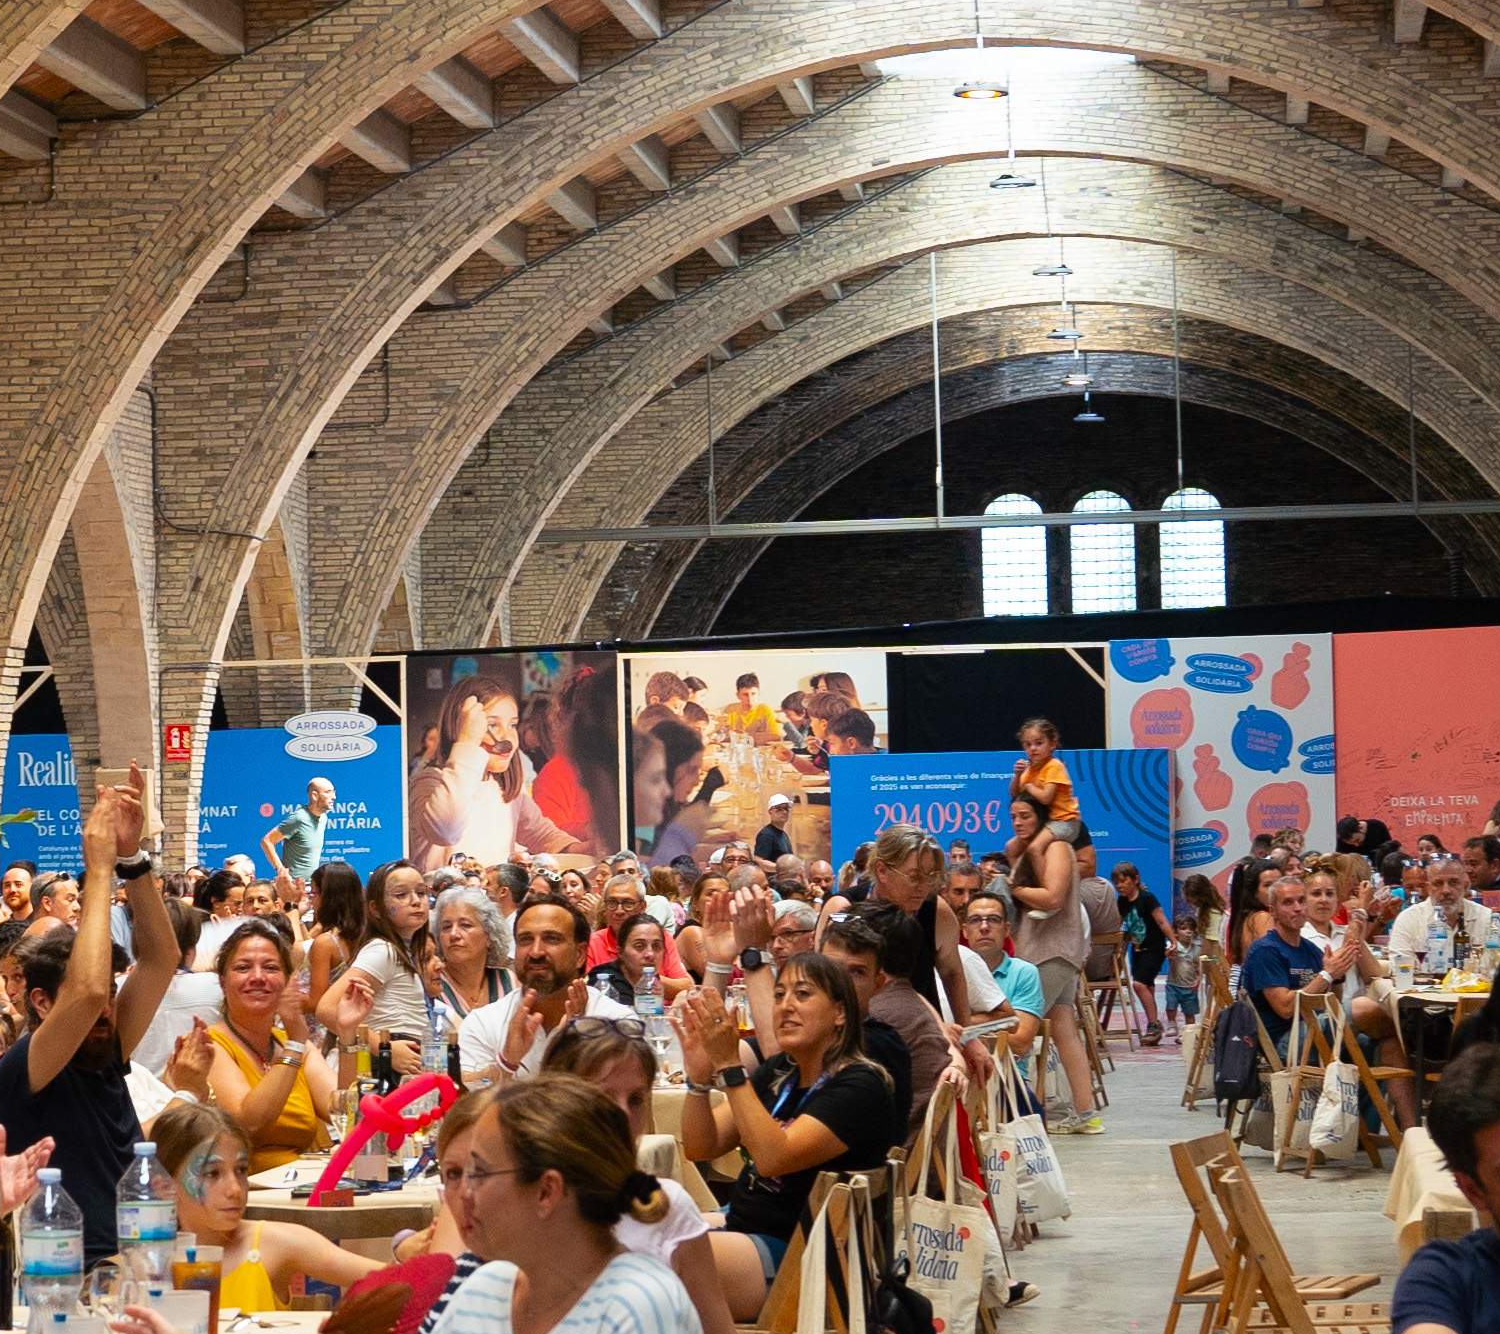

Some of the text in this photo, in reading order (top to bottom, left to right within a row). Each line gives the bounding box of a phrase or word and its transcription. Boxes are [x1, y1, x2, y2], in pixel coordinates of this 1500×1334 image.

[1194, 659, 1247, 672] ARROSSADA
[296, 721, 366, 730] ARROSSADA
[300, 740, 361, 752] SOLIDÀRIA
[1390, 794, 1479, 807] DEIXA LA TEVA
[38, 810, 52, 821] EL
[281, 802, 368, 817] MAANÇA
[327, 816, 382, 830] NTÀRIA
[38, 824, 56, 836] DE
